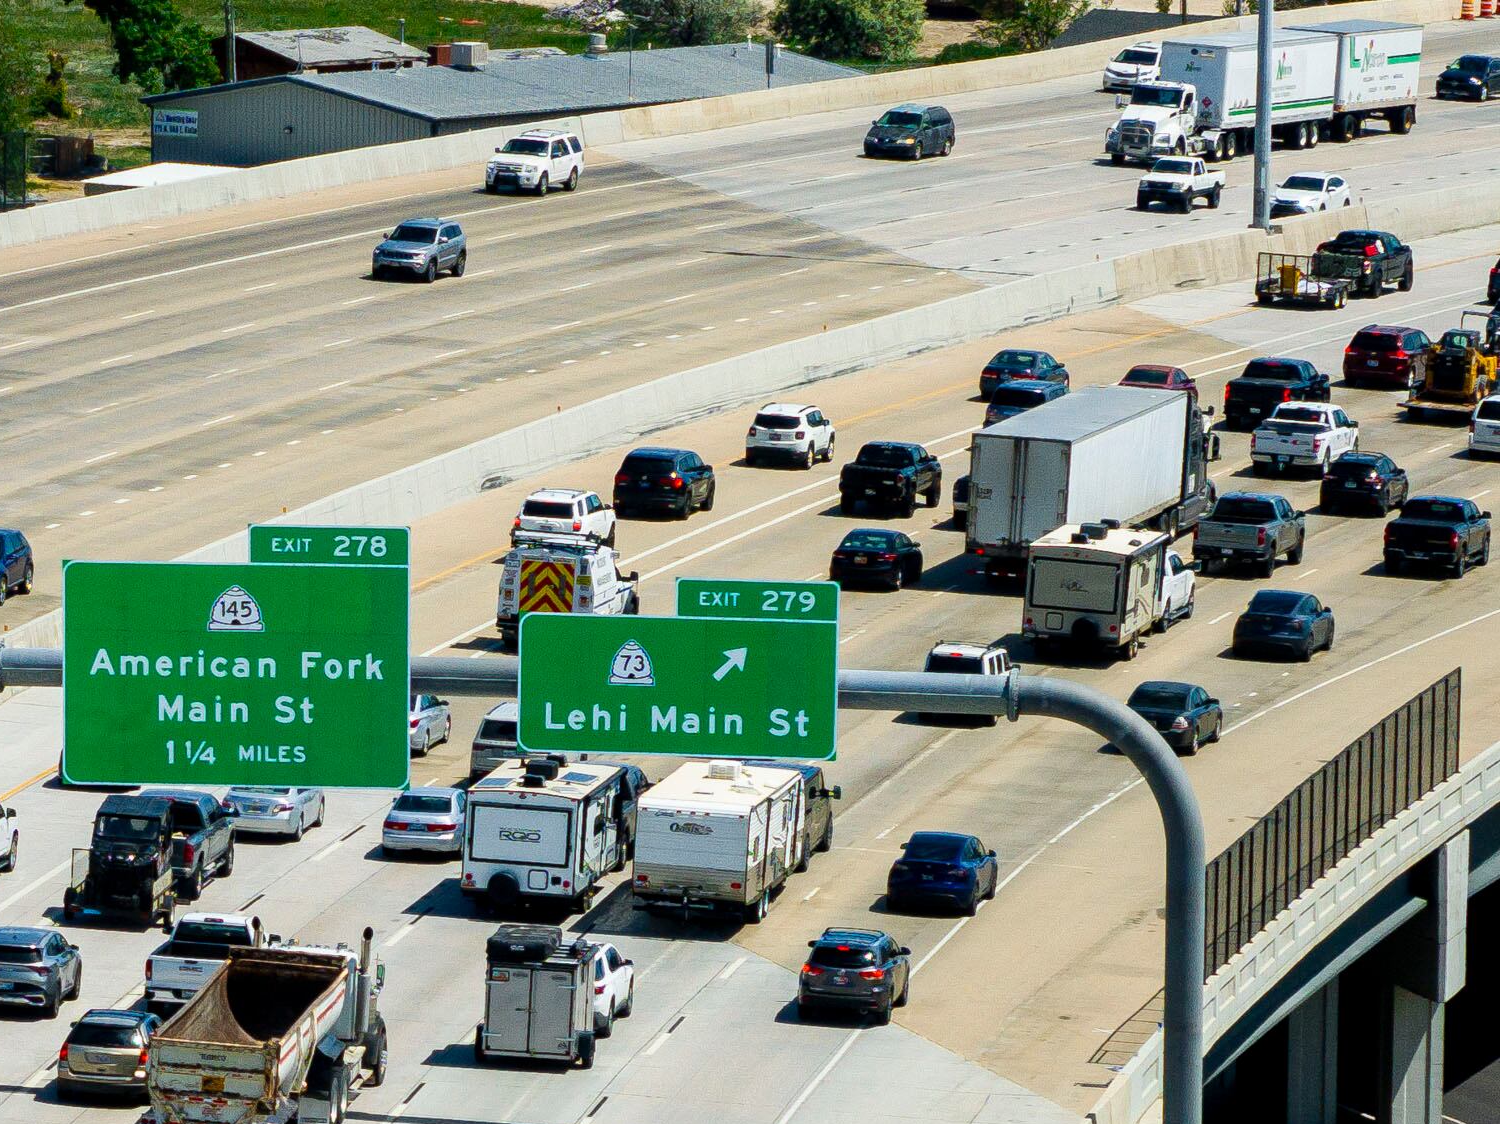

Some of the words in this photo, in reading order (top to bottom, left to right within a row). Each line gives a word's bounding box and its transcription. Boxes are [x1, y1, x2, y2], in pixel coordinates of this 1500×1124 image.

[271, 537, 312, 553] EXIT
[333, 535, 387, 557] 278
[220, 600, 253, 618] 145
[699, 591, 741, 607] EXIT
[761, 590, 815, 613] 279
[90, 648, 277, 678] American
[301, 651, 384, 680] Fork
[620, 655, 645, 672] 73
[158, 694, 249, 723] Main
[274, 696, 314, 724] St
[545, 702, 627, 732] Lehi
[651, 705, 743, 735] Main
[768, 708, 809, 737] St
[238, 746, 307, 763] MILES
